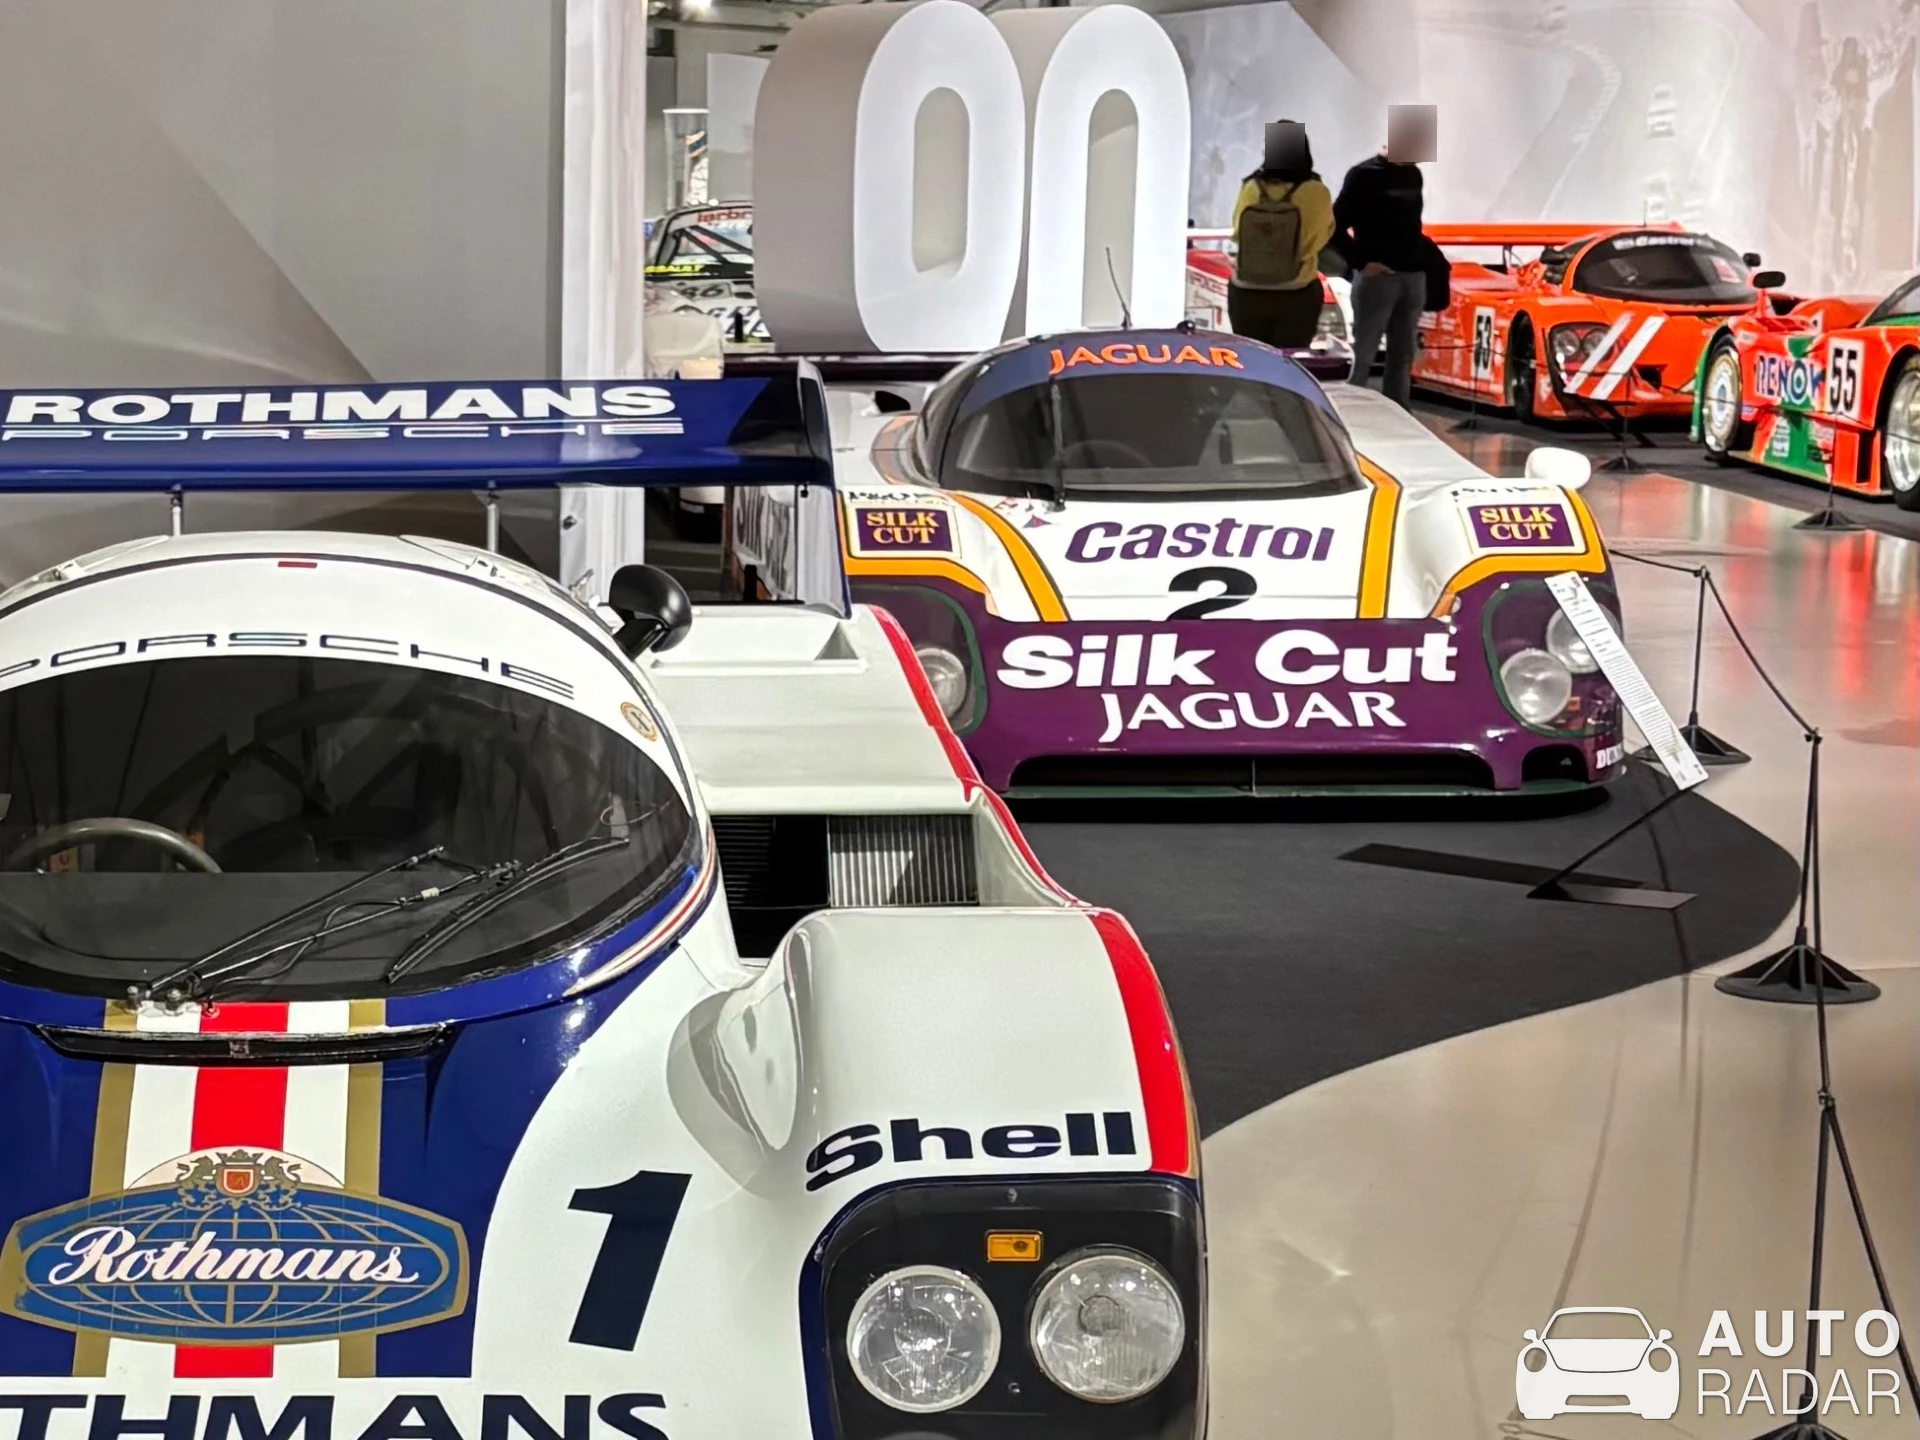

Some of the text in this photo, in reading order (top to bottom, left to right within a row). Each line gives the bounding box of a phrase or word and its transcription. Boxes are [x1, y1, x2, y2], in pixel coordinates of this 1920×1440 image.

[1049, 344, 1244, 376] JAGUAR
[1830, 346, 1860, 413] 55
[5, 386, 676, 423] ROTHMANS
[2, 424, 685, 441] PORSCHE
[866, 512, 940, 529] SILK
[872, 527, 935, 544] CUT
[1480, 506, 1557, 525] SILK
[1489, 522, 1553, 541] CUT
[1065, 518, 1335, 563] Castrol
[1167, 566, 1258, 621] 2
[997, 628, 1458, 690] Silk Cut
[1098, 690, 1407, 744] JAGUAR
[805, 1111, 1136, 1192] Shell
[47, 1226, 420, 1285] Rothmans
[567, 1170, 693, 1352] 1
